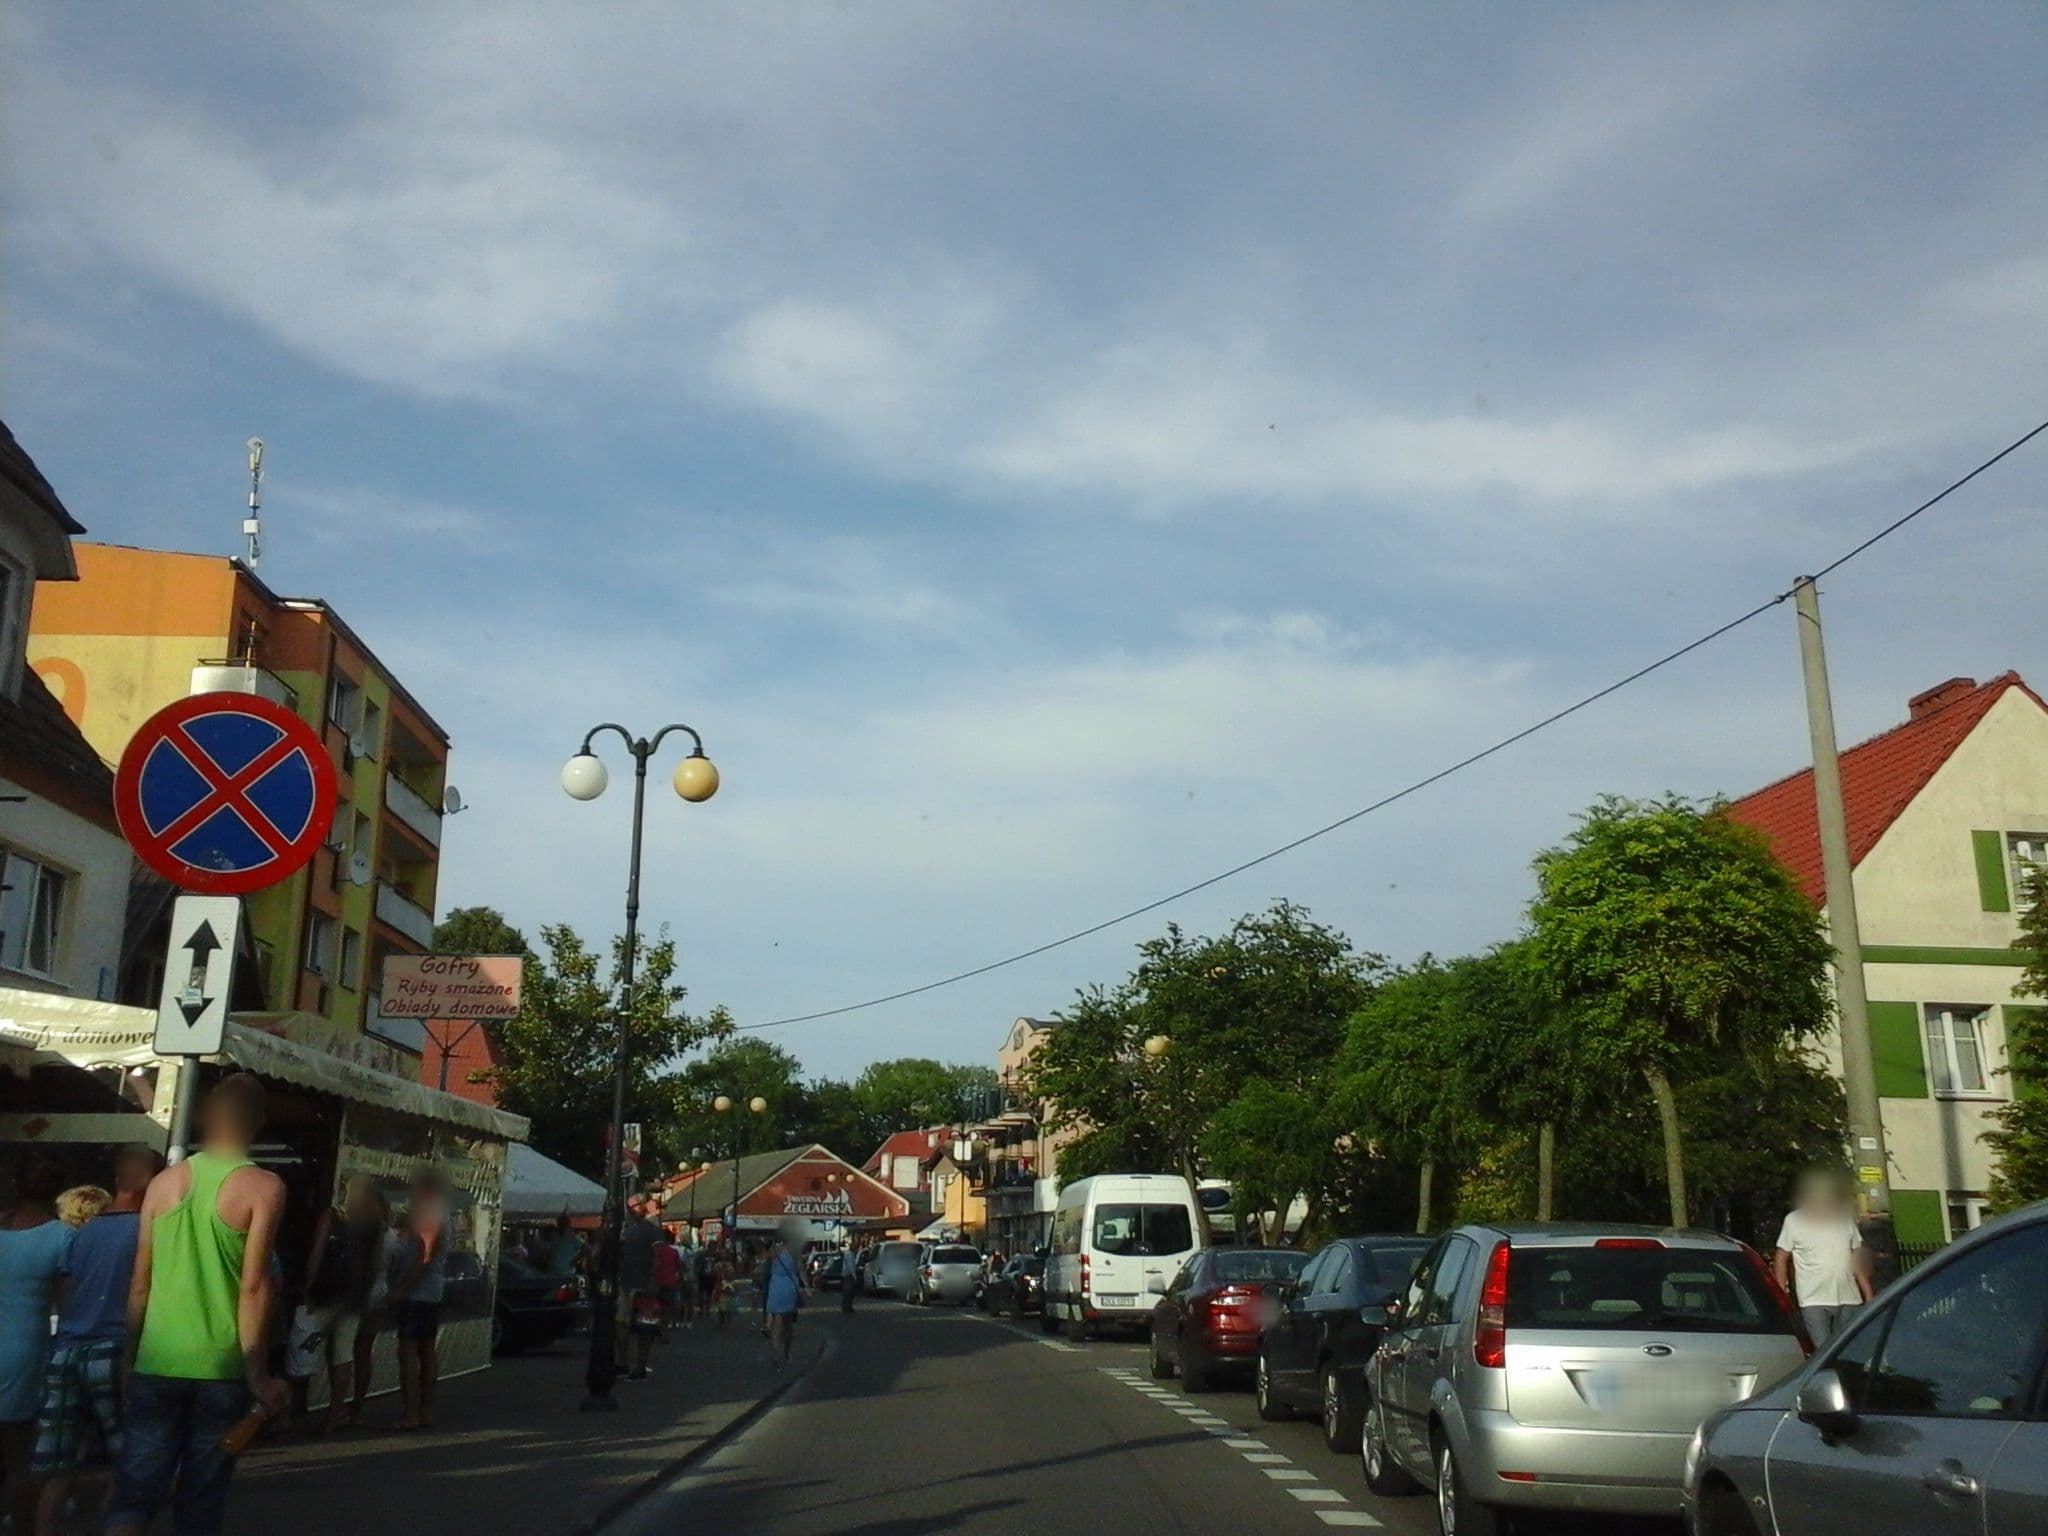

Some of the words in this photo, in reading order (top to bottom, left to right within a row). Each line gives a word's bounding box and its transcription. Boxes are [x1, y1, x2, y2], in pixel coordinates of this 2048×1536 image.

[420, 956, 480, 979] Gofry
[397, 979, 438, 996] Ryby
[384, 999, 441, 1018] Obiady
[449, 1000, 518, 1015] domowe
[62, 1026, 155, 1044] domowe
